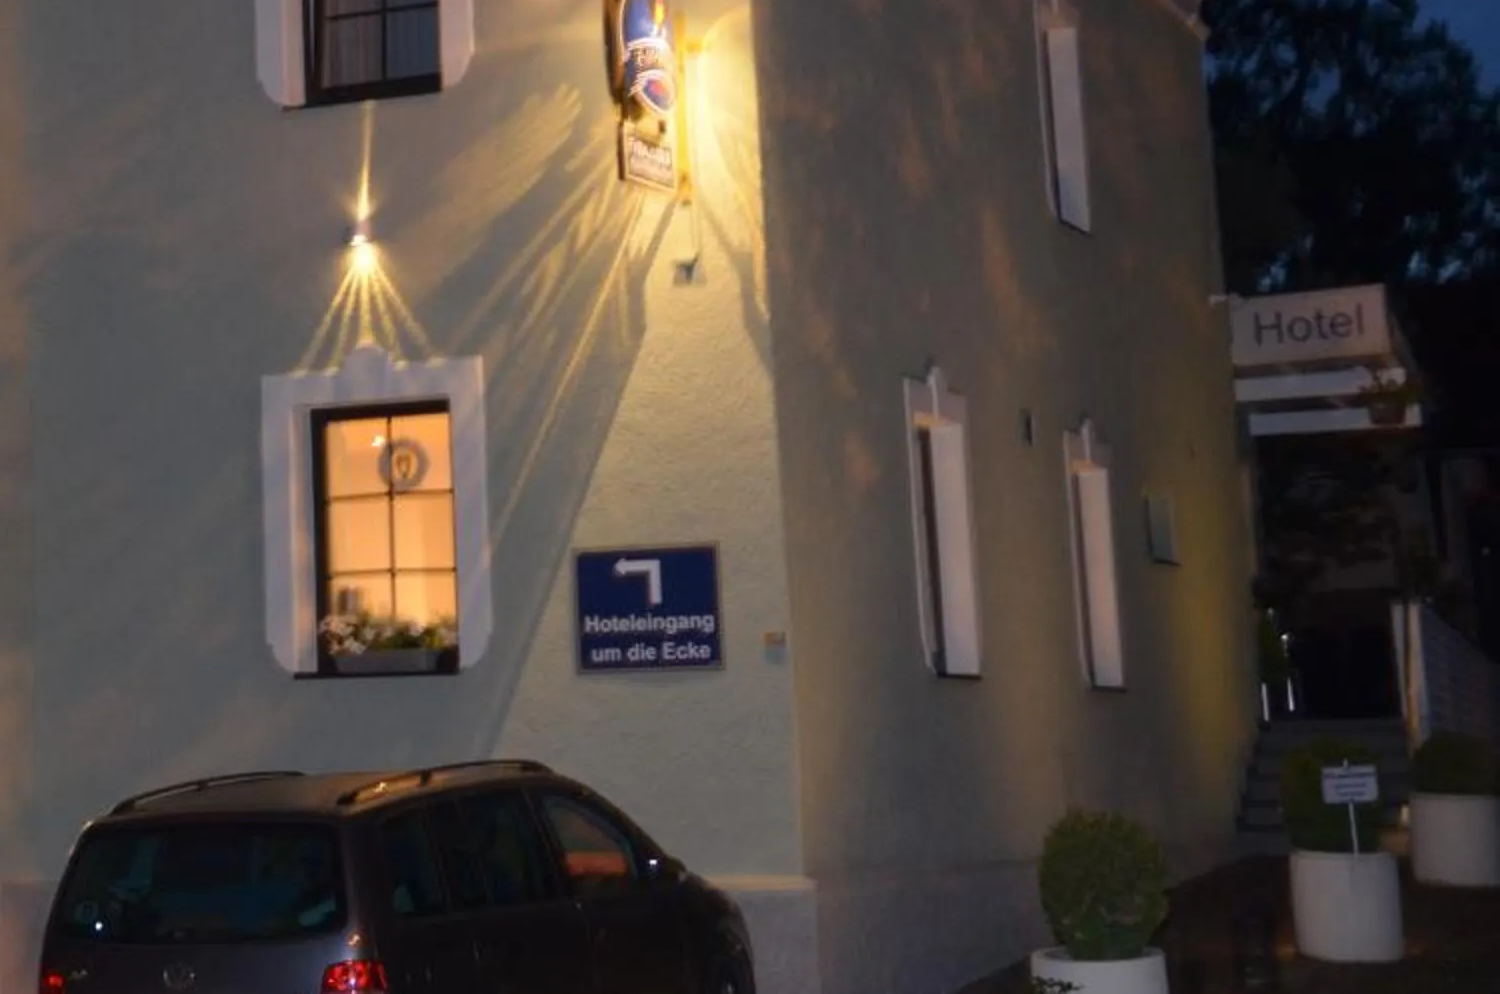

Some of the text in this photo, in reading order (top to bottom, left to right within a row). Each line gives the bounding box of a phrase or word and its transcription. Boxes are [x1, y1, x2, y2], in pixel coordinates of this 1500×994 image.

[1254, 303, 1364, 346] Hotel
[584, 614, 715, 634] Hoteleingang
[592, 641, 711, 662] um die Ecke
